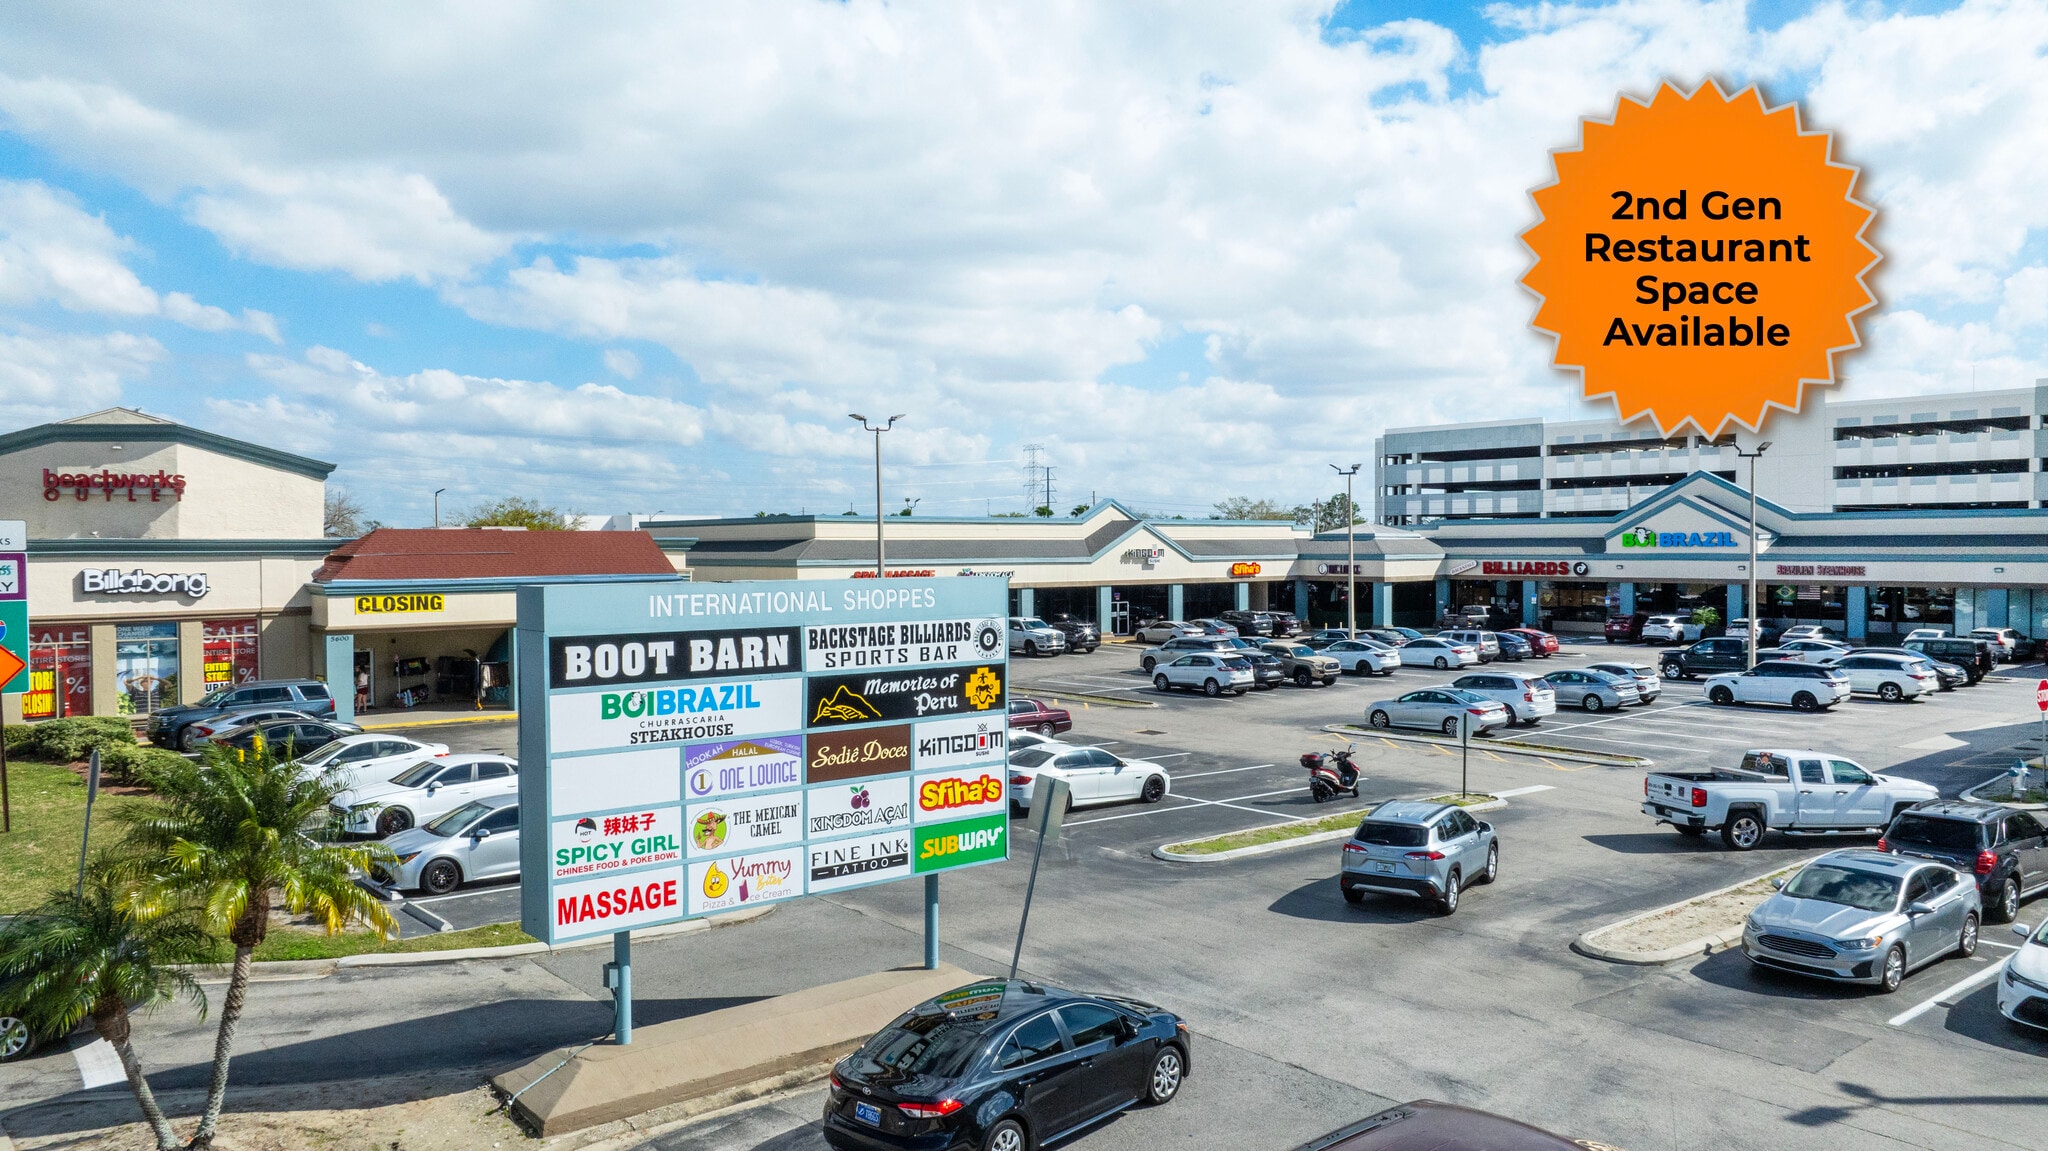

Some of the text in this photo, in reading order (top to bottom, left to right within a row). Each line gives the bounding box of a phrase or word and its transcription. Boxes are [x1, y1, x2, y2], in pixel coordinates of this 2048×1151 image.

[43, 468, 186, 489] beachworks
[43, 488, 185, 502] OUTLET
[1659, 532, 1737, 547] BRAZIL
[1233, 562, 1261, 576] Sfiha's
[1482, 561, 1569, 575] BILLIARDS
[357, 595, 443, 613] CLOSING
[650, 588, 936, 617] INTERNATIONAL SHOPPES
[29, 631, 86, 649] SALE
[203, 626, 255, 643] SALE
[809, 621, 971, 650] BACKSTAGE BILLIARDS
[986, 635, 992, 644] 8
[565, 635, 790, 681] BOOT BARN
[825, 645, 957, 668] SPORTS BAR
[30, 671, 55, 690] TORE
[66, 676, 86, 694] %
[864, 674, 959, 696] Memories of
[22, 693, 55, 714] CLOSING
[914, 692, 958, 716] Peru
[640, 714, 725, 729] CHURRASCARIA
[630, 723, 734, 744] STEAKHOUSE
[686, 745, 724, 768] HOOKAH
[732, 746, 758, 756] HALAL
[812, 739, 908, 768] Sodiê Doces
[720, 761, 797, 790] ONE LOUNGE
[921, 776, 1001, 808] Sfiha's
[604, 813, 656, 836] 辣妹子
[733, 805, 798, 825] THE MEXICAN
[811, 810, 872, 832] KINGDOM
[750, 822, 782, 837] CAMEL
[556, 834, 680, 866] SPICY GIRL
[812, 839, 907, 866] FINE INK
[920, 826, 1004, 859] SUBWAY
[557, 864, 593, 876] CHINESE
[596, 861, 619, 870] FOOD
[631, 855, 652, 864] POKE
[655, 852, 678, 860] BOWL
[731, 857, 791, 880] Yummy
[833, 858, 888, 876] TATTOO
[756, 874, 783, 890] Bites
[558, 880, 677, 926] MASSAGE
[702, 899, 726, 910] Pizza
[728, 897, 735, 905] &
[762, 888, 791, 899] Cream
